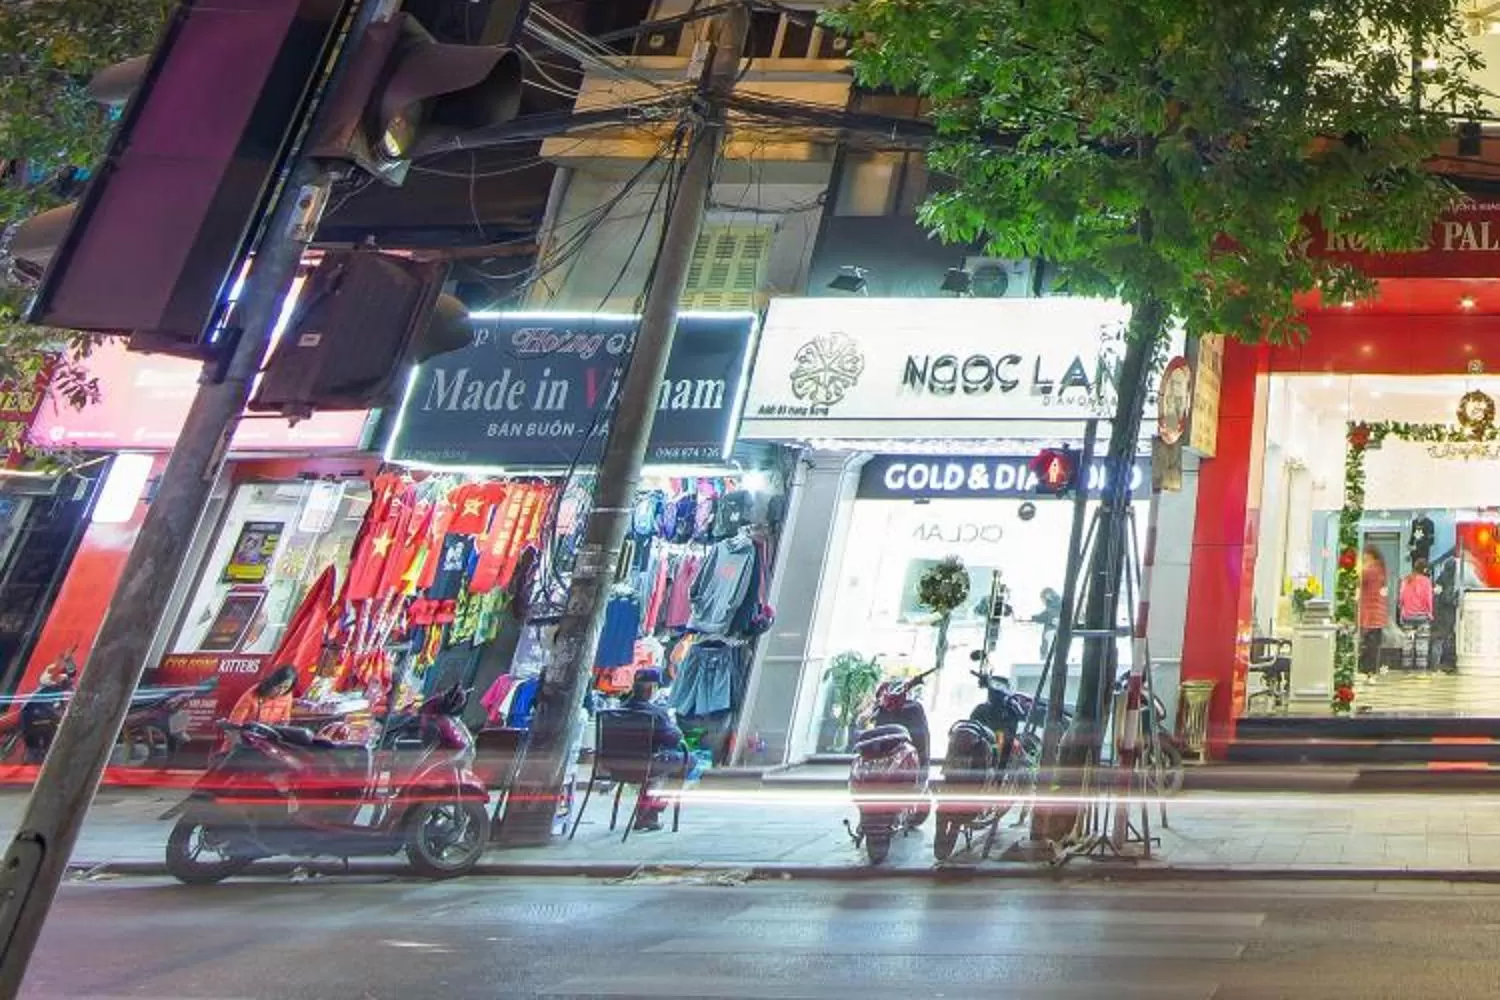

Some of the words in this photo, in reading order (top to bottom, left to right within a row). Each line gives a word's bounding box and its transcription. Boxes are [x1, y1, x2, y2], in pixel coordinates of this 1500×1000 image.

[421, 367, 526, 412] Made
[532, 368, 570, 411] in
[582, 368, 726, 411] Vinam
[884, 463, 964, 491] GOLD
[967, 463, 990, 491] &
